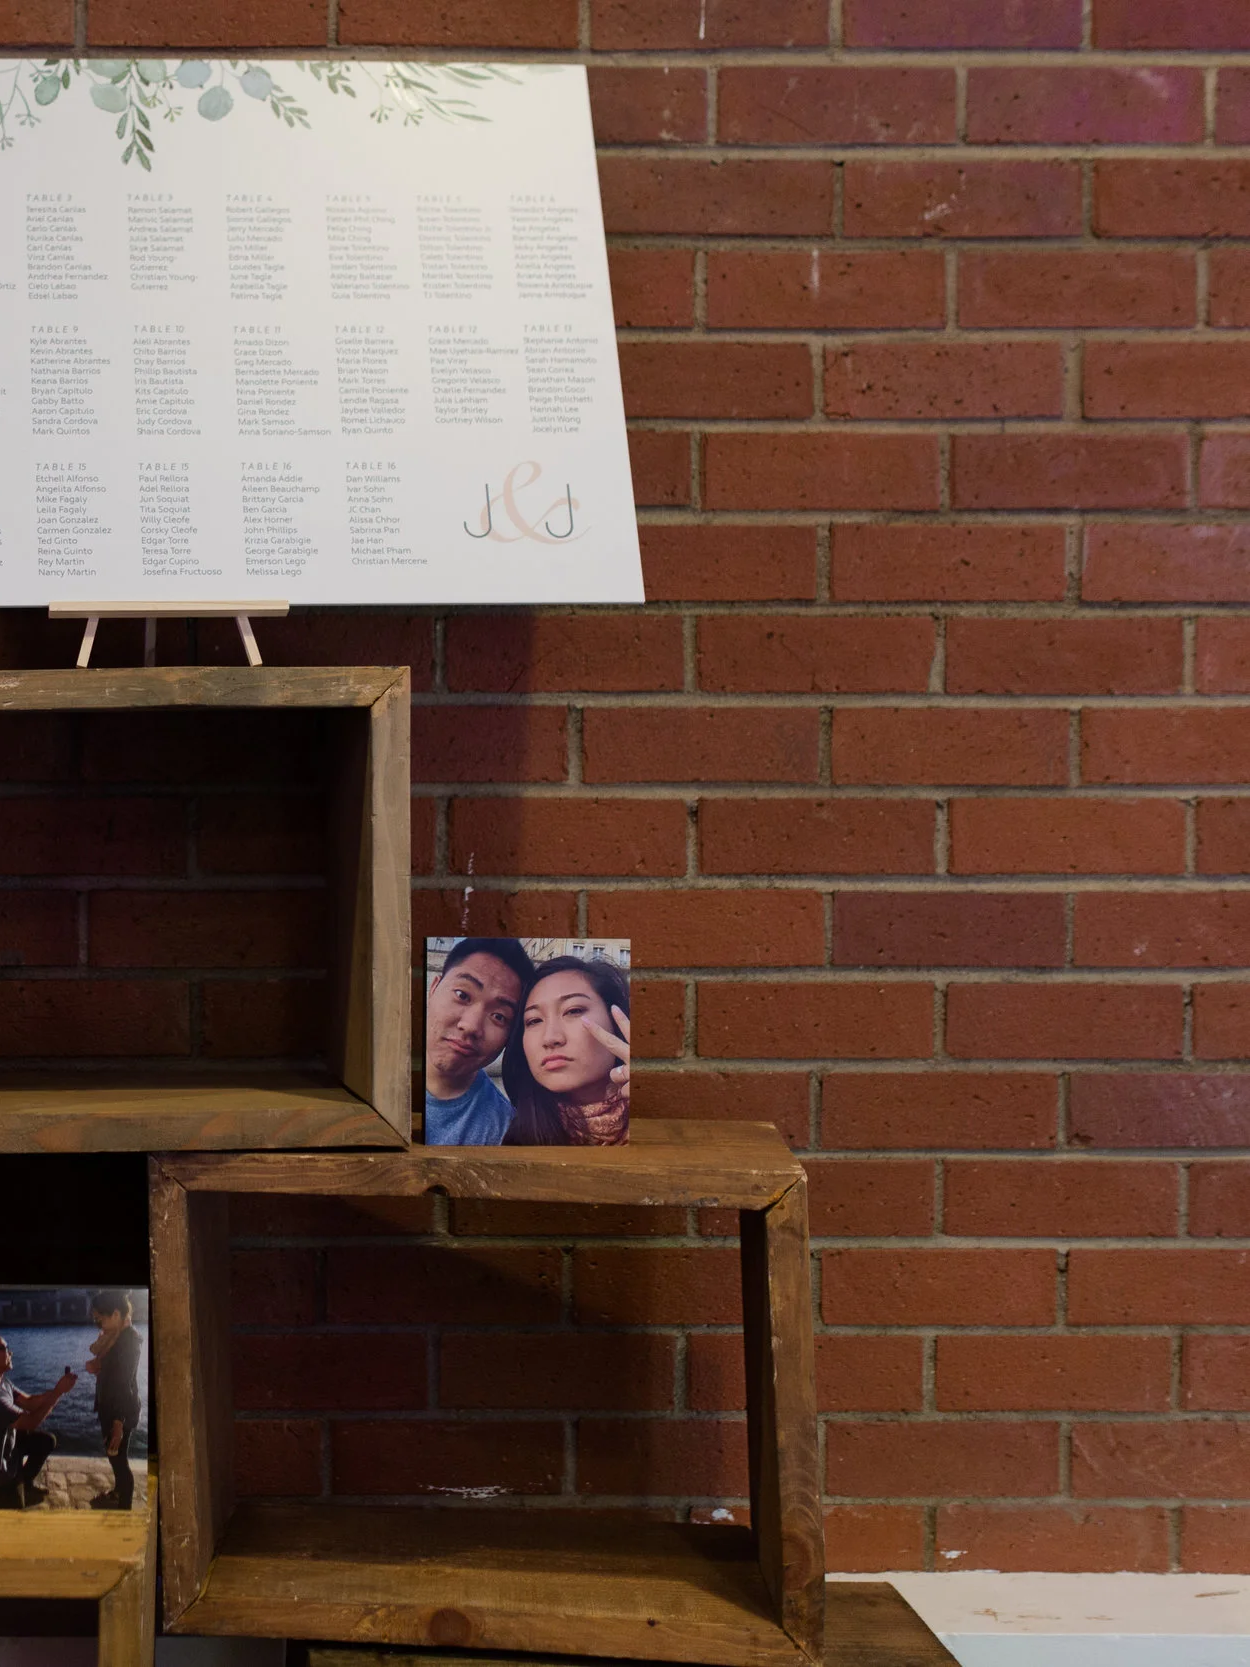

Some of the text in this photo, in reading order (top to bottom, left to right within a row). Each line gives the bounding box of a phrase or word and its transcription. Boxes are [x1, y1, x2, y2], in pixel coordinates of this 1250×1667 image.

[36, 485, 72, 495] Angelita
[270, 485, 320, 495] Beauchamp
[142, 558, 199, 568] Edgar Cupino
[285, 558, 306, 567] Lego
